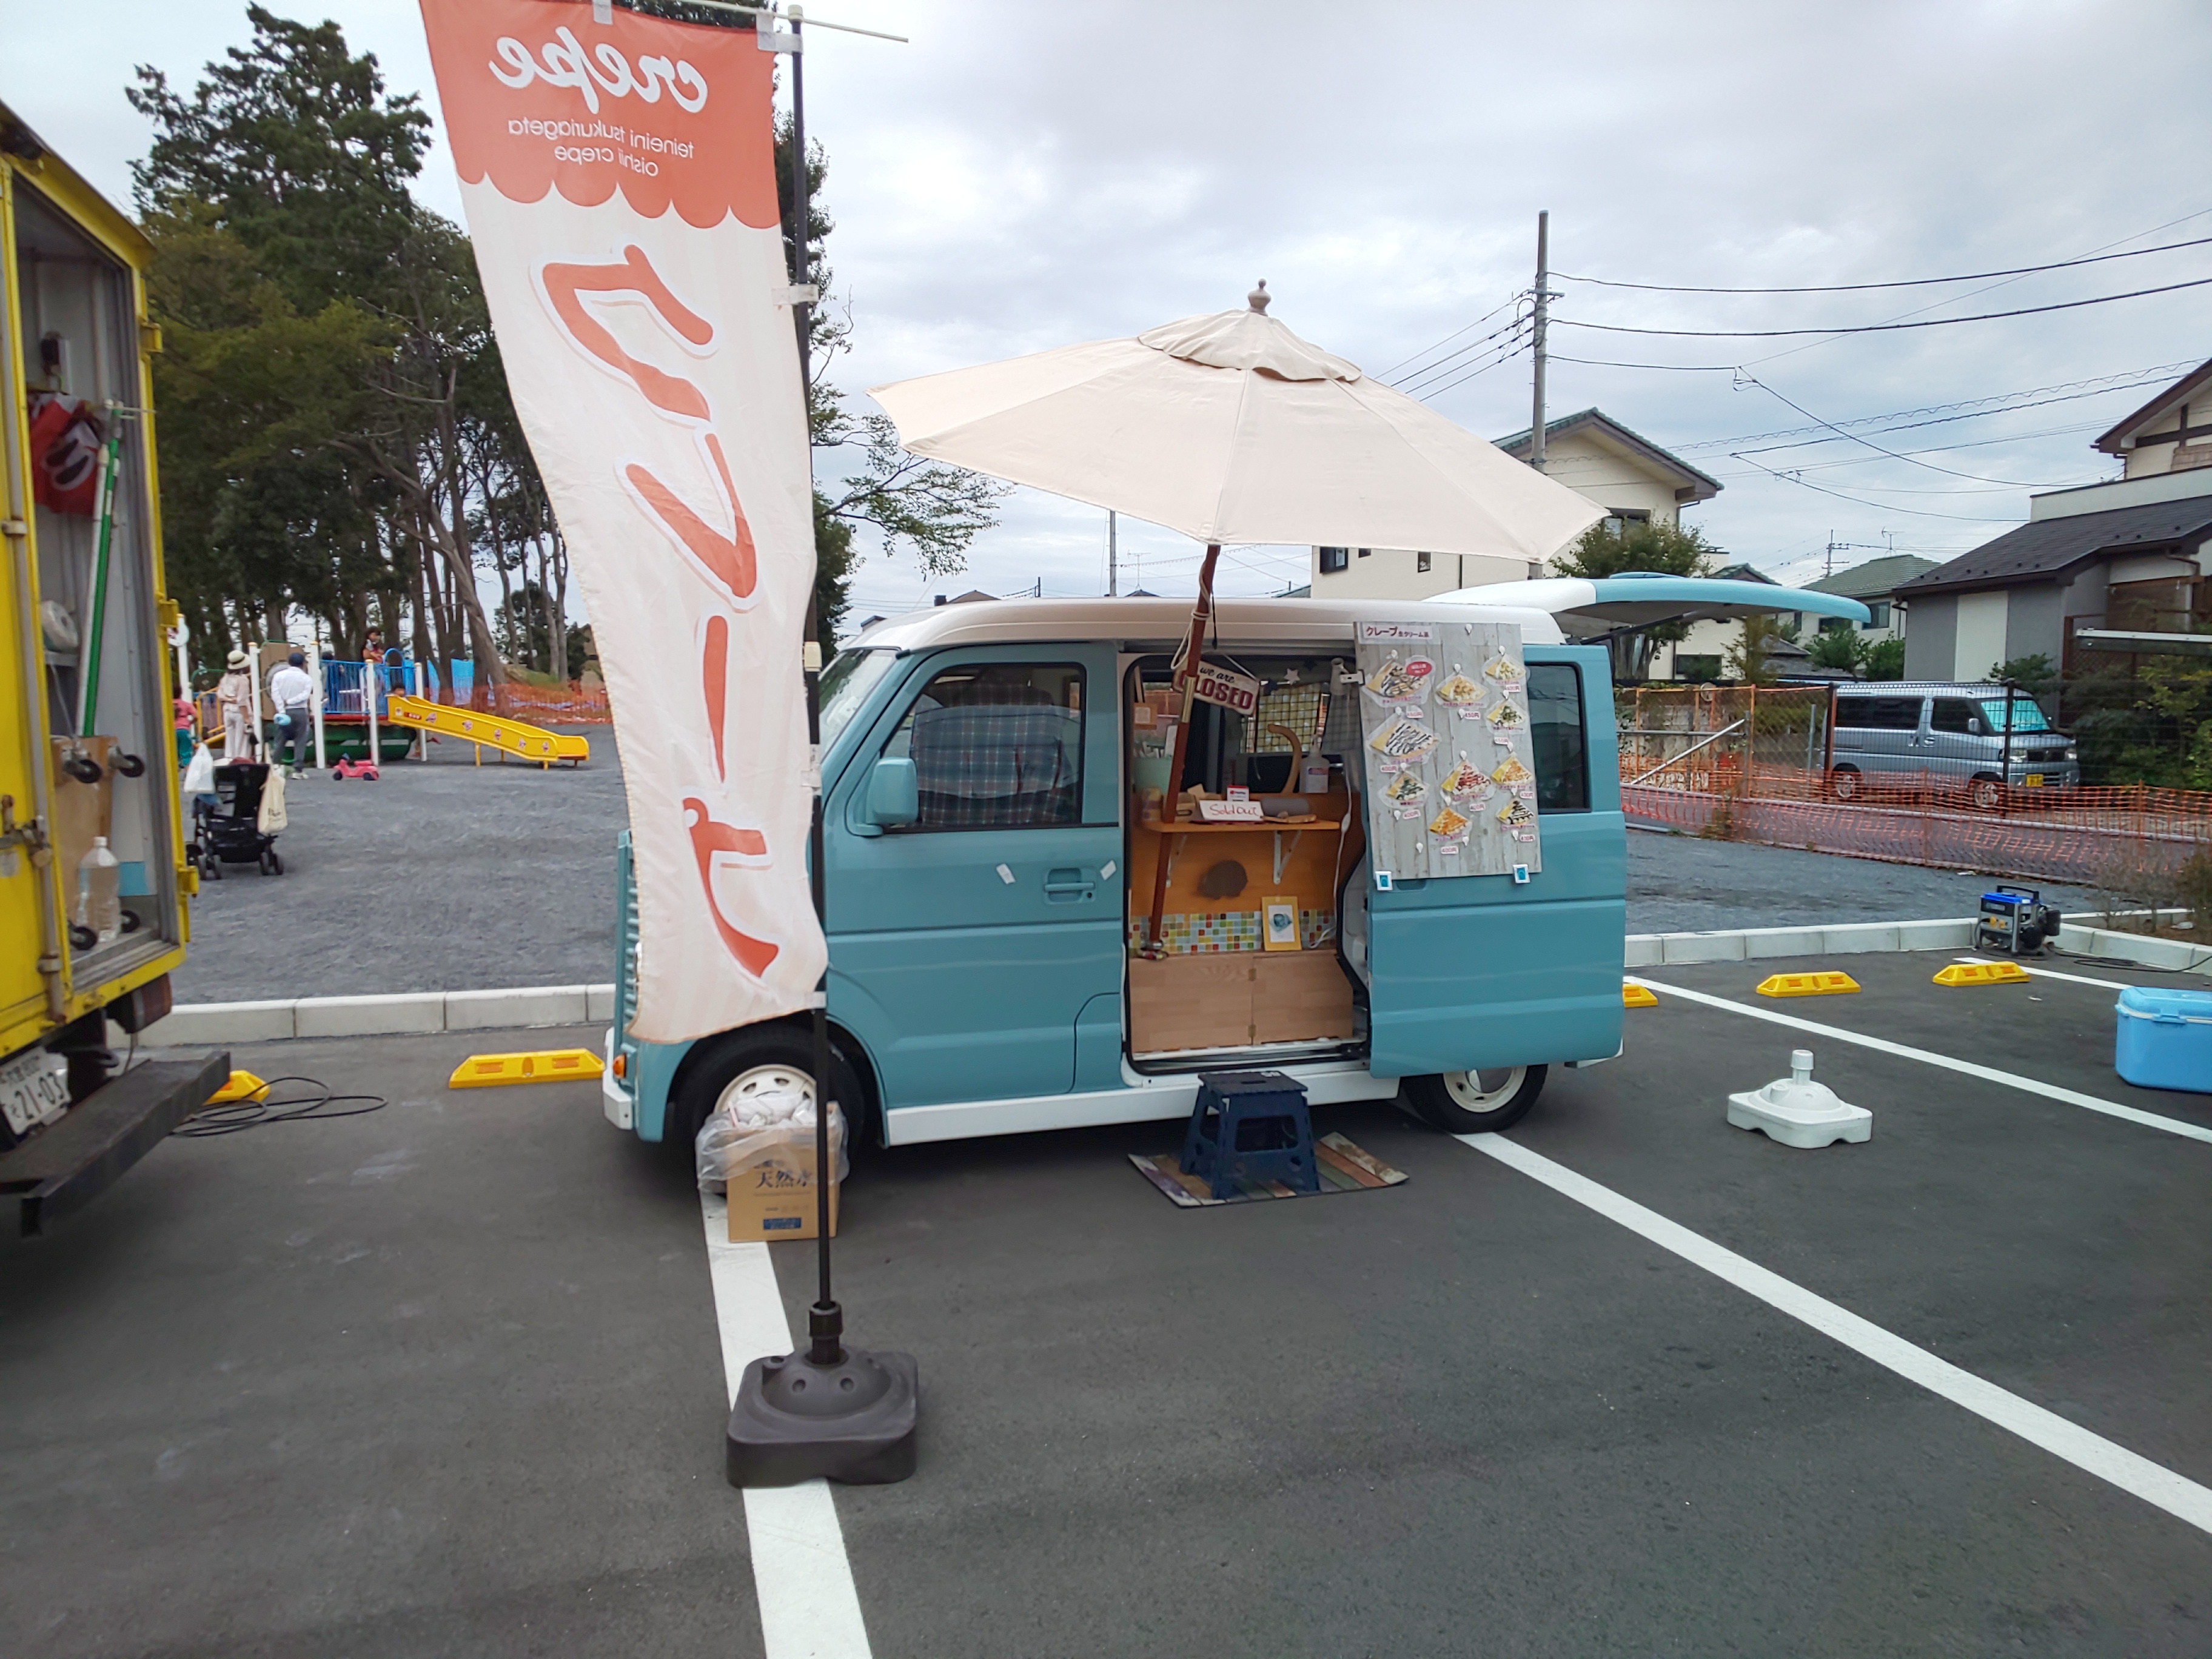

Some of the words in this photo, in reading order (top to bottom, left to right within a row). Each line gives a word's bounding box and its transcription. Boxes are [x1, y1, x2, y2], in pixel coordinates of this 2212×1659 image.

[1200, 667, 1215, 677] we
[1216, 672, 1235, 683] are
[1210, 803, 1235, 816] Sold
